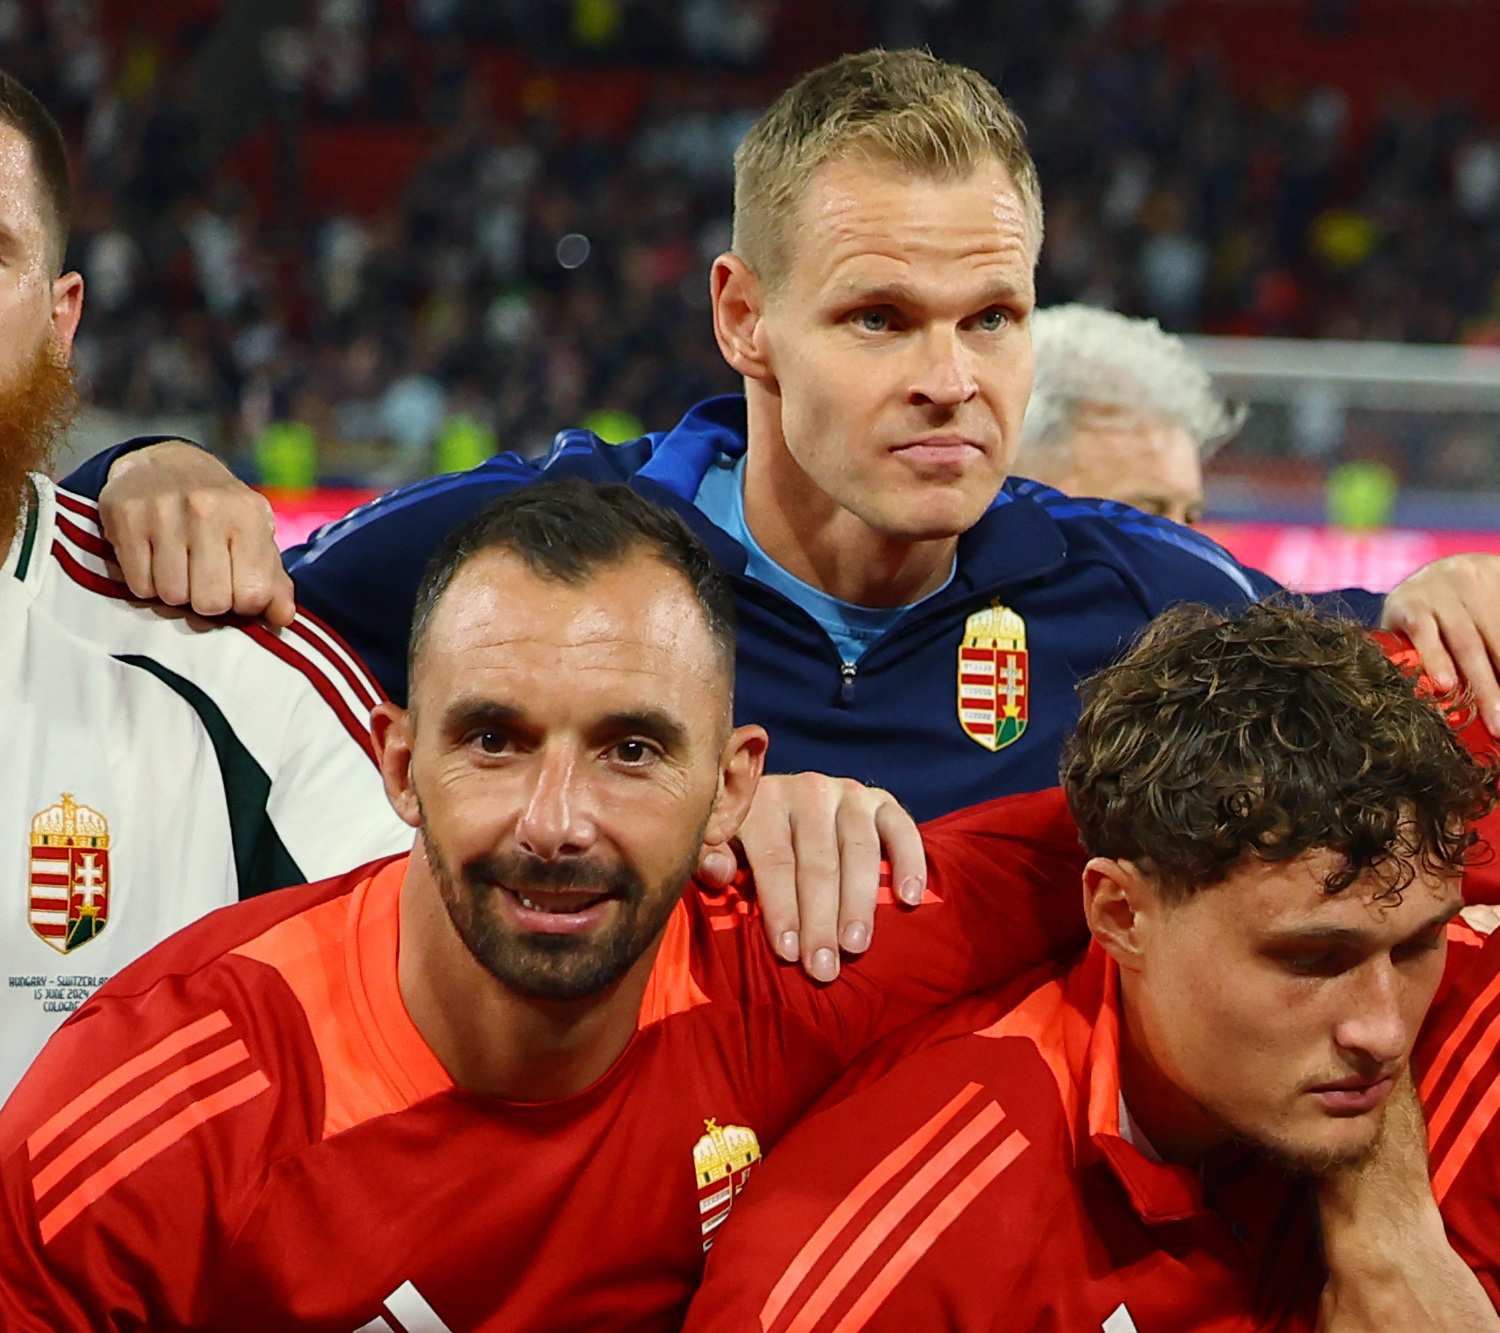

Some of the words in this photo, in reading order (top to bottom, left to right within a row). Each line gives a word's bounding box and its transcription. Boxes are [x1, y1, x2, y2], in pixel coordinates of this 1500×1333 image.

[9, 976, 47, 987] HUNGARY
[34, 989, 43, 999] 15
[45, 989, 65, 999] JUNE
[67, 989, 90, 999] 2024
